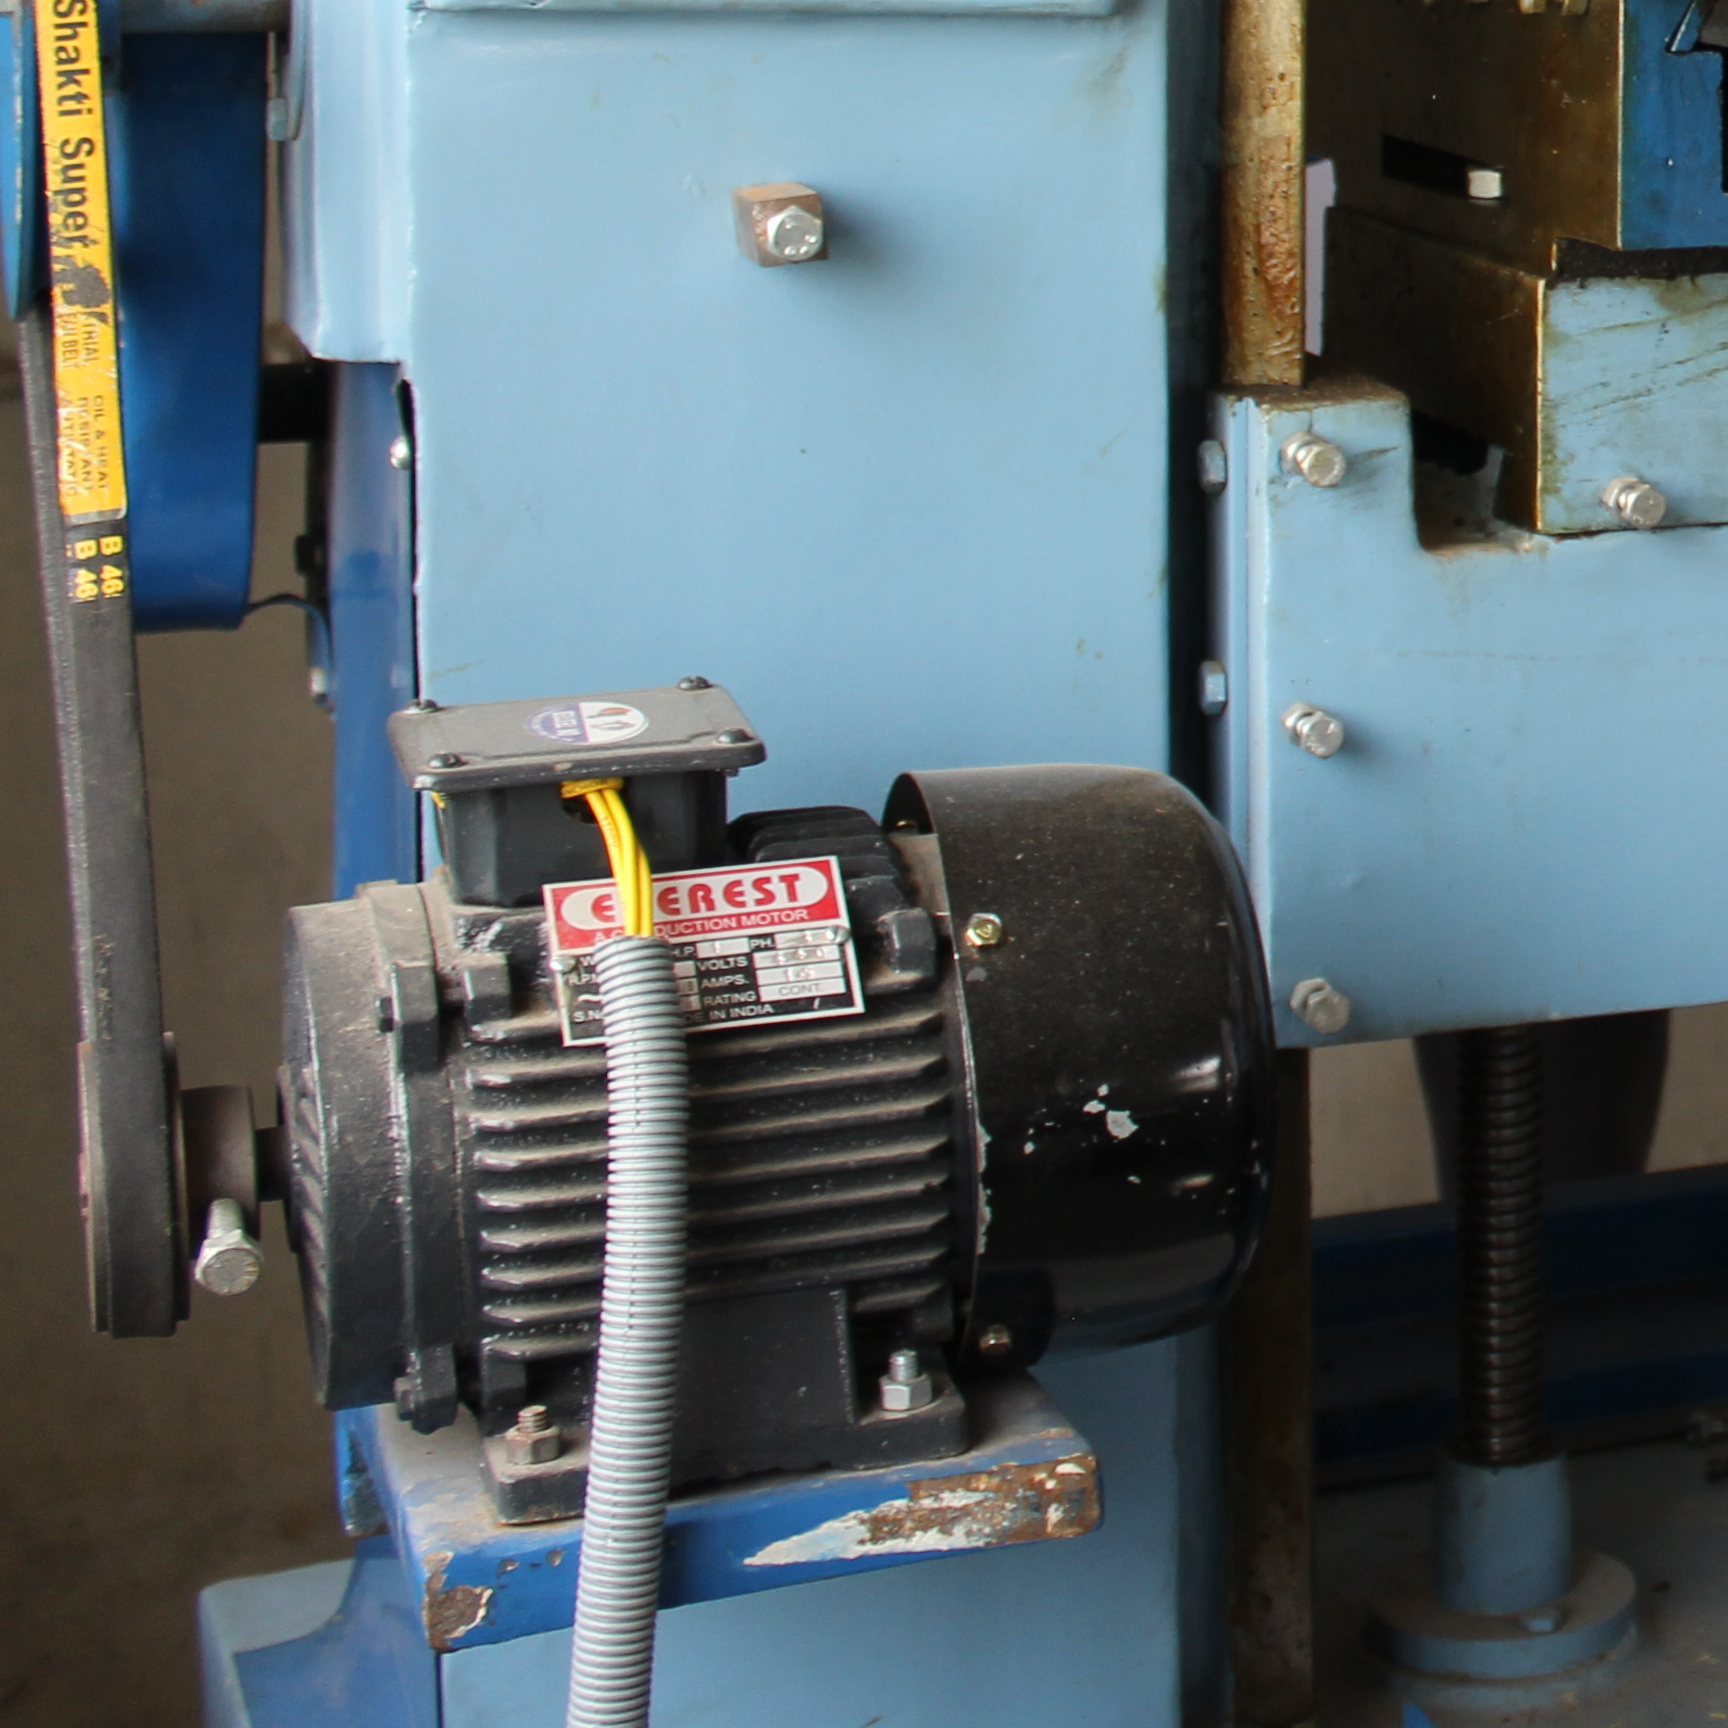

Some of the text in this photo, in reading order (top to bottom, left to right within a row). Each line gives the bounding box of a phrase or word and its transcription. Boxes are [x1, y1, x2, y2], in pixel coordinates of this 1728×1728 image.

[53, 136, 94, 249] Super
[74, 540, 99, 560] B
[99, 536, 123, 555] B
[591, 873, 800, 922] EEREST
[653, 917, 737, 937] DUCTION
[741, 909, 809, 926] MOTOR
[697, 956, 748, 970] VOLTS
[703, 991, 757, 1006] RATING
[709, 1008, 726, 1019] IN
[730, 1004, 774, 1017] INDIA
